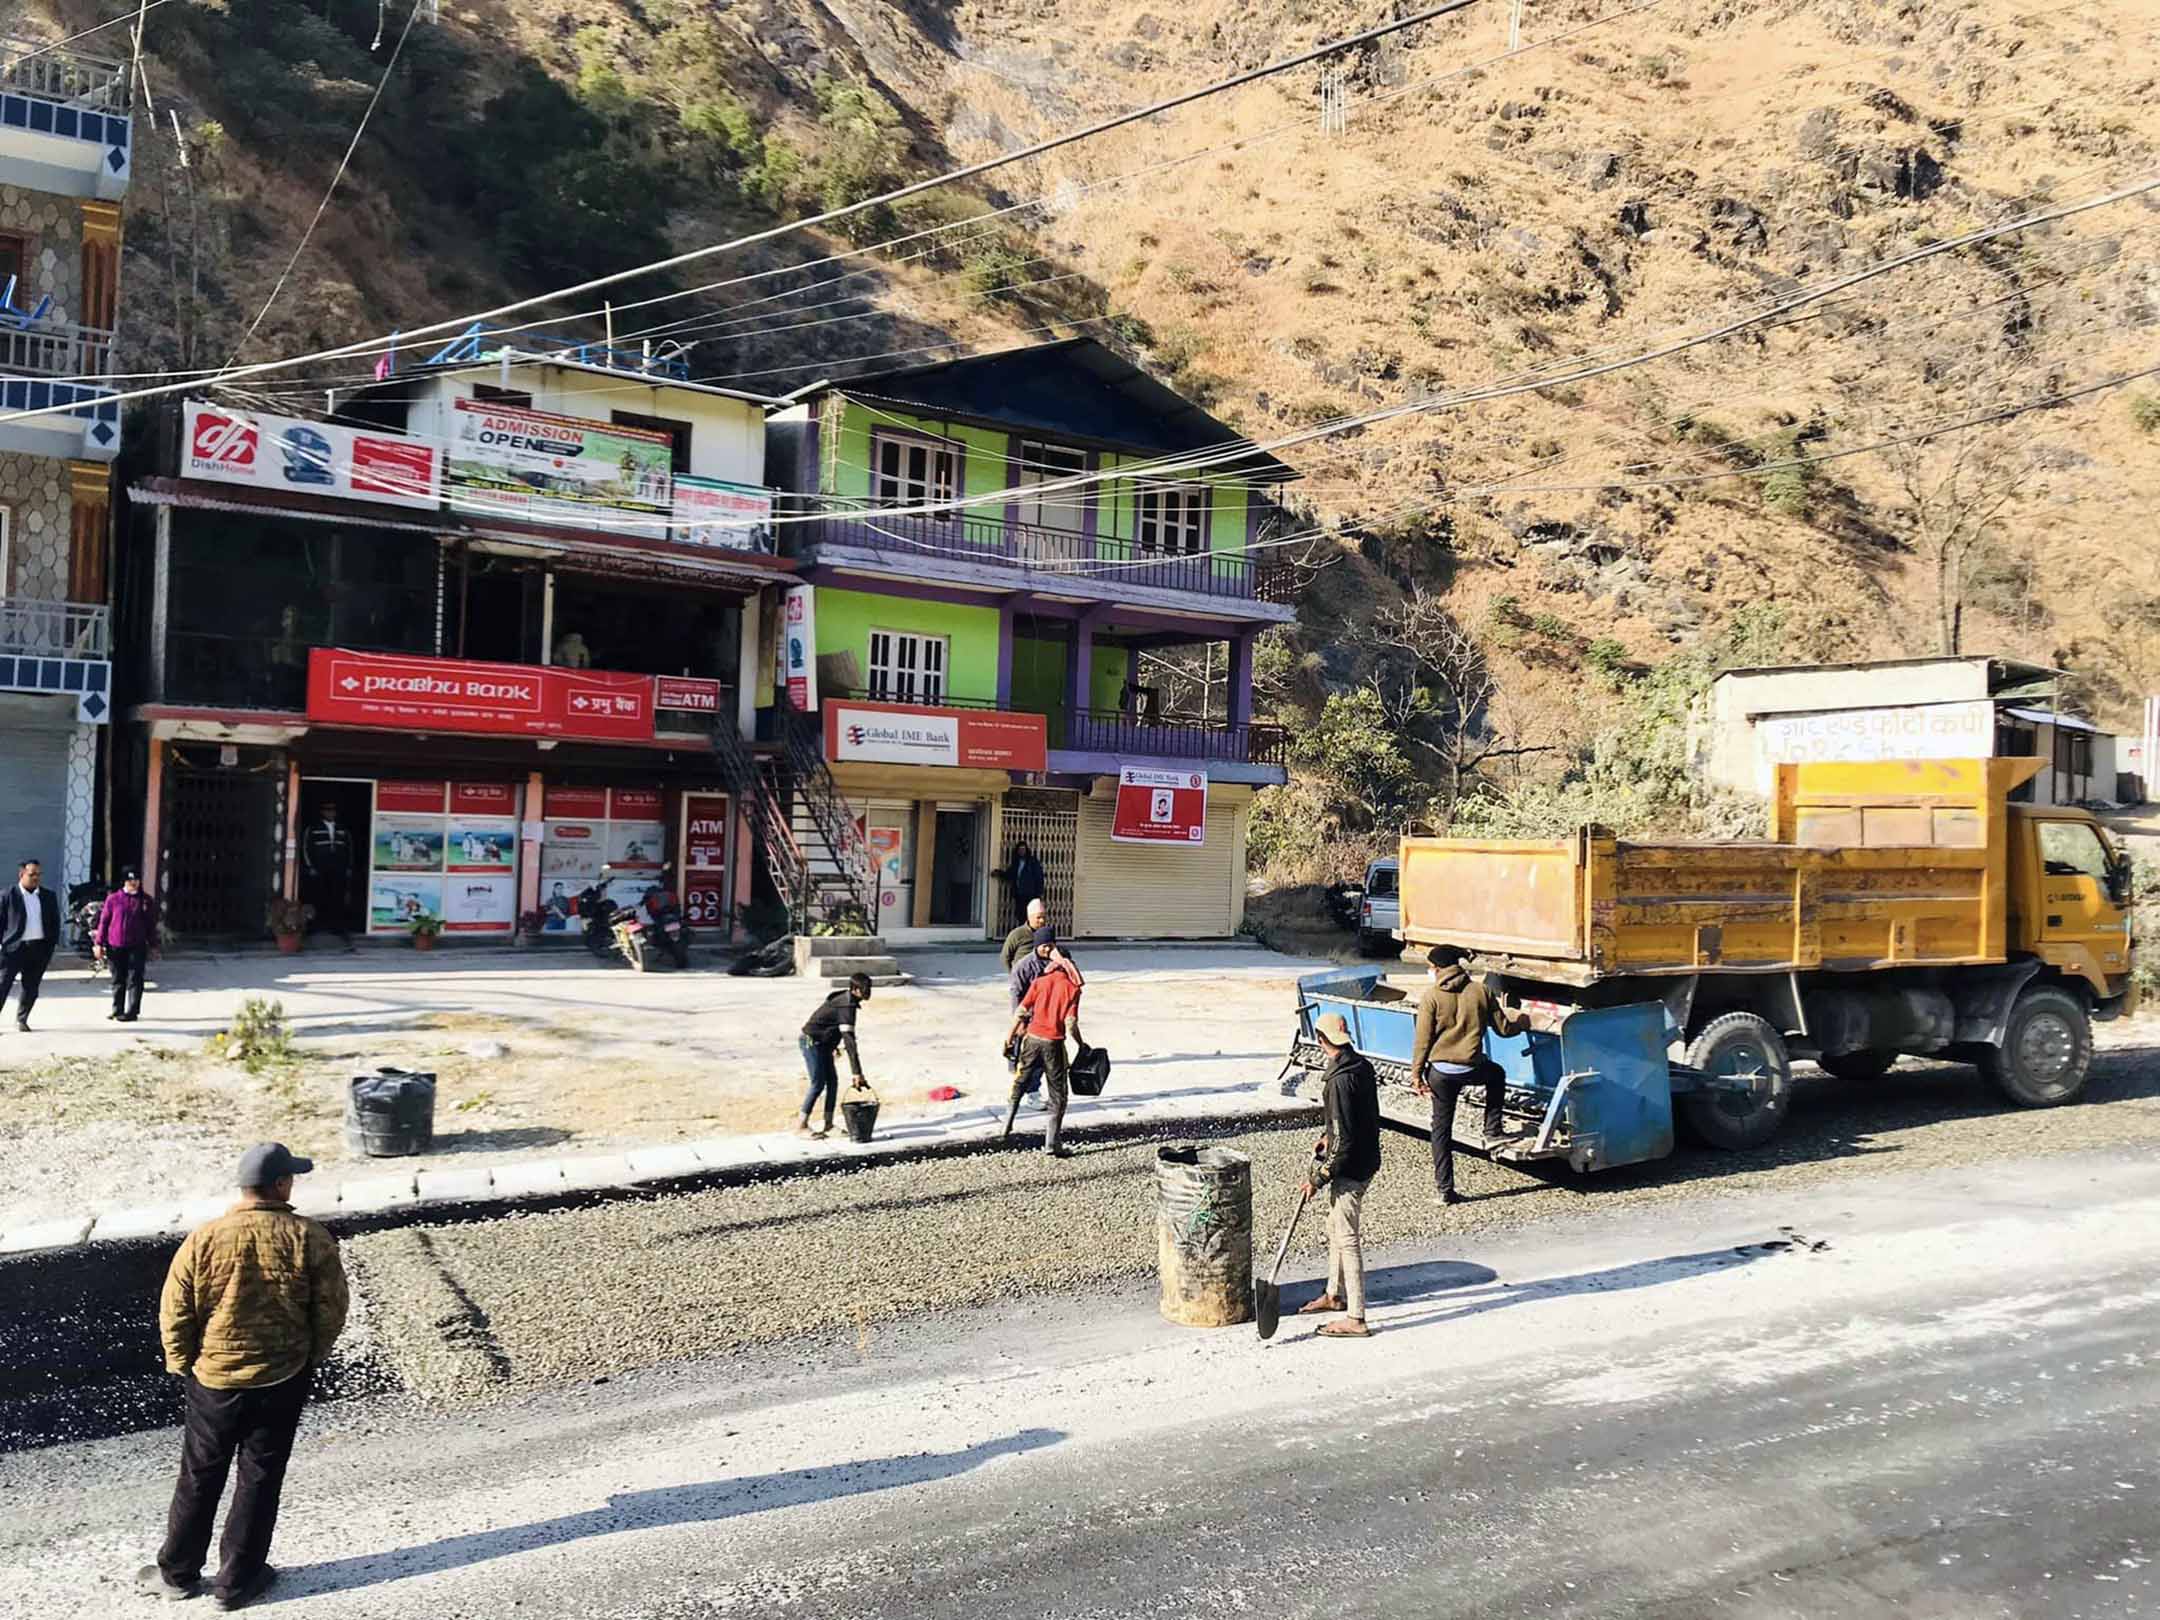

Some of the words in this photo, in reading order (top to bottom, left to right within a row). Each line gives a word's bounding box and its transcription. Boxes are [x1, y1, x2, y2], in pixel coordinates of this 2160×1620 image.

[482, 417, 584, 443] ADMISSION
[479, 431, 541, 451] OPEN
[191, 458, 256, 476] DishH
[682, 693, 715, 708] ATM
[866, 727, 898, 740] Global
[926, 731, 950, 743] Bank
[689, 819, 724, 835] ATM
